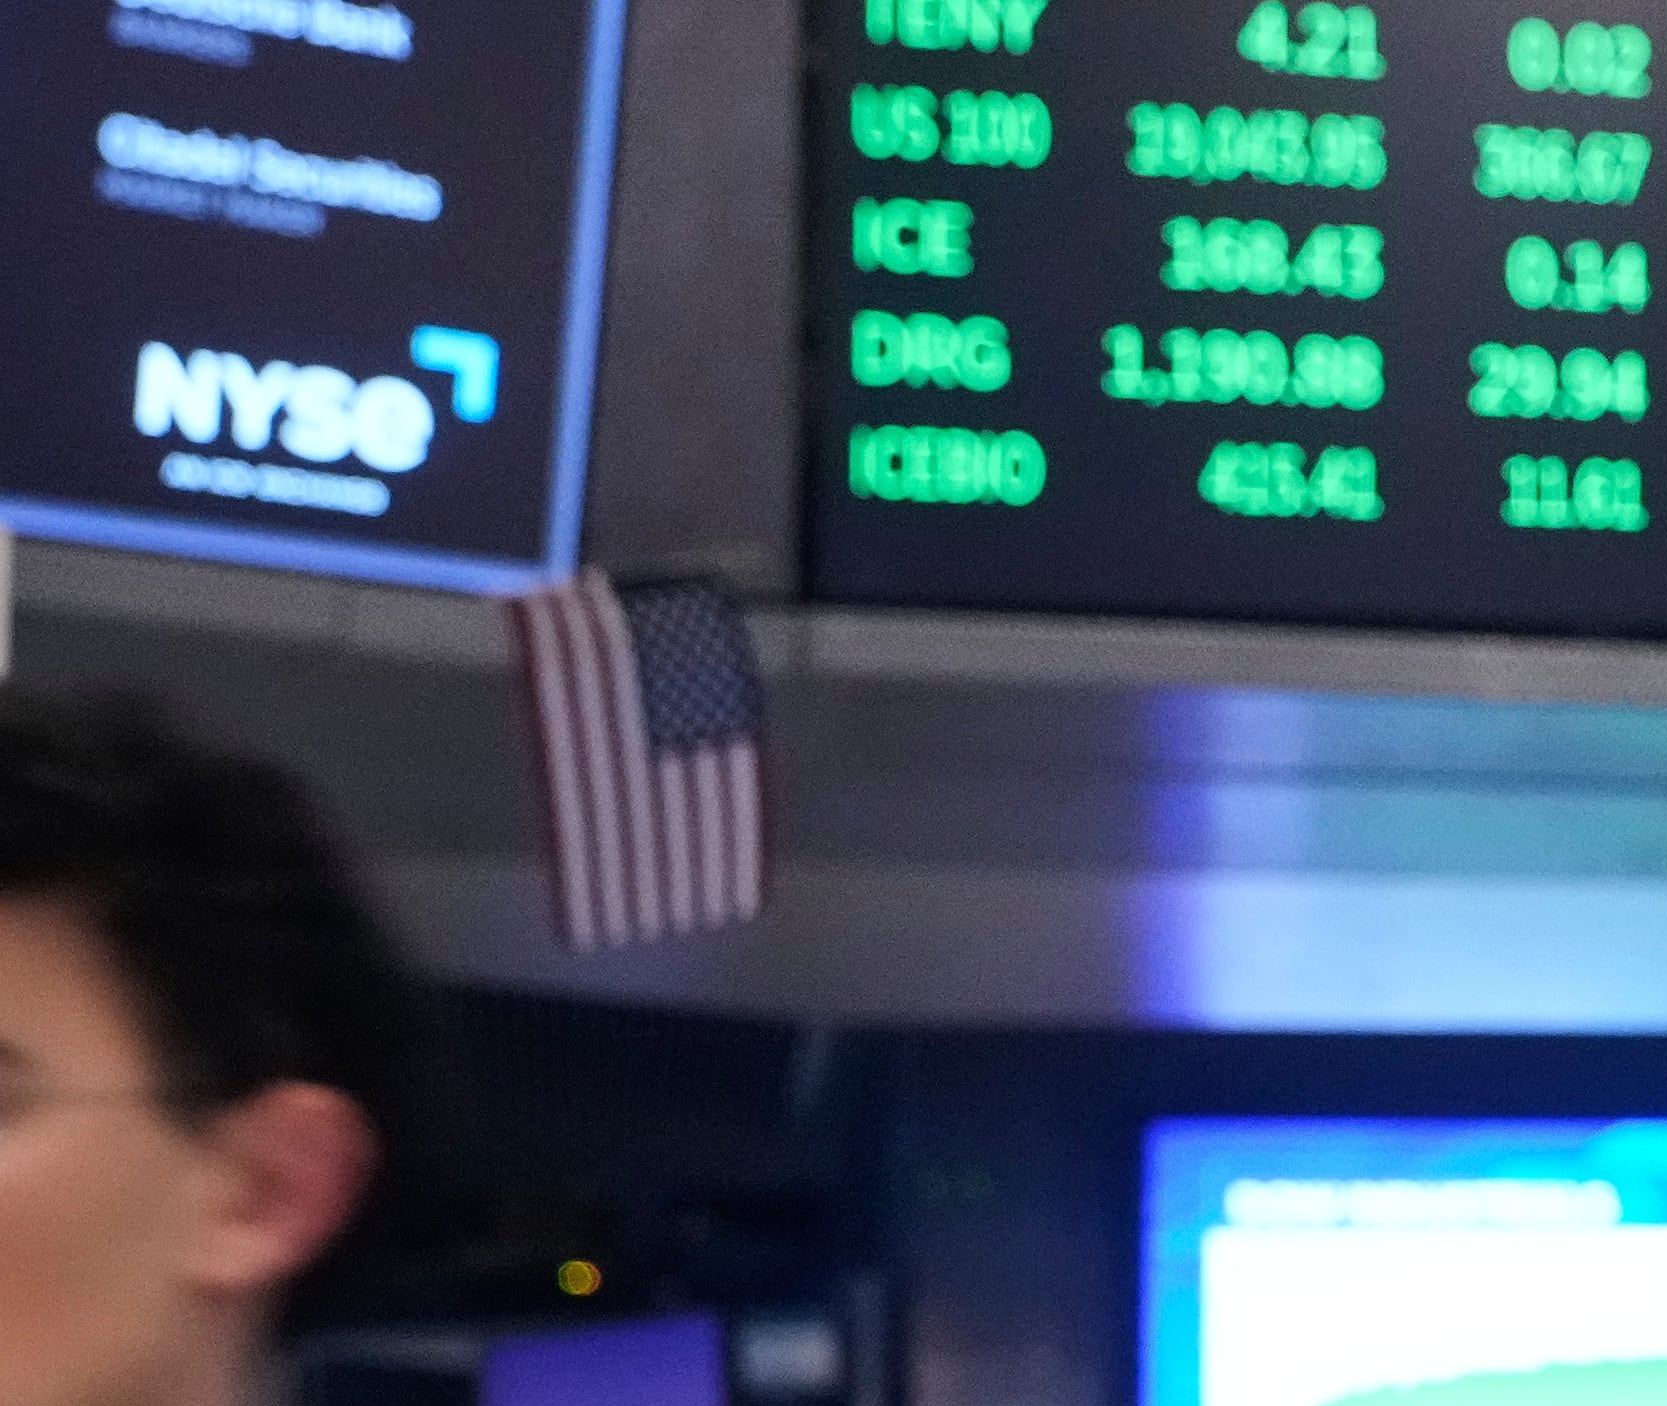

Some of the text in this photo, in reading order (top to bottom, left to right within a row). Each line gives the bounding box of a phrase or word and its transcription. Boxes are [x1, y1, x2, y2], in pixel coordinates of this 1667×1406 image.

[1508, 19, 1651, 98] 0.02
[851, 86, 940, 161] US
[945, 91, 1051, 168] 100
[853, 199, 971, 276] ICE
[1506, 236, 1649, 312] 0.14
[852, 311, 1011, 391] DRG
[1469, 343, 1648, 420] 29.94
[1503, 455, 1647, 531] 11.61
